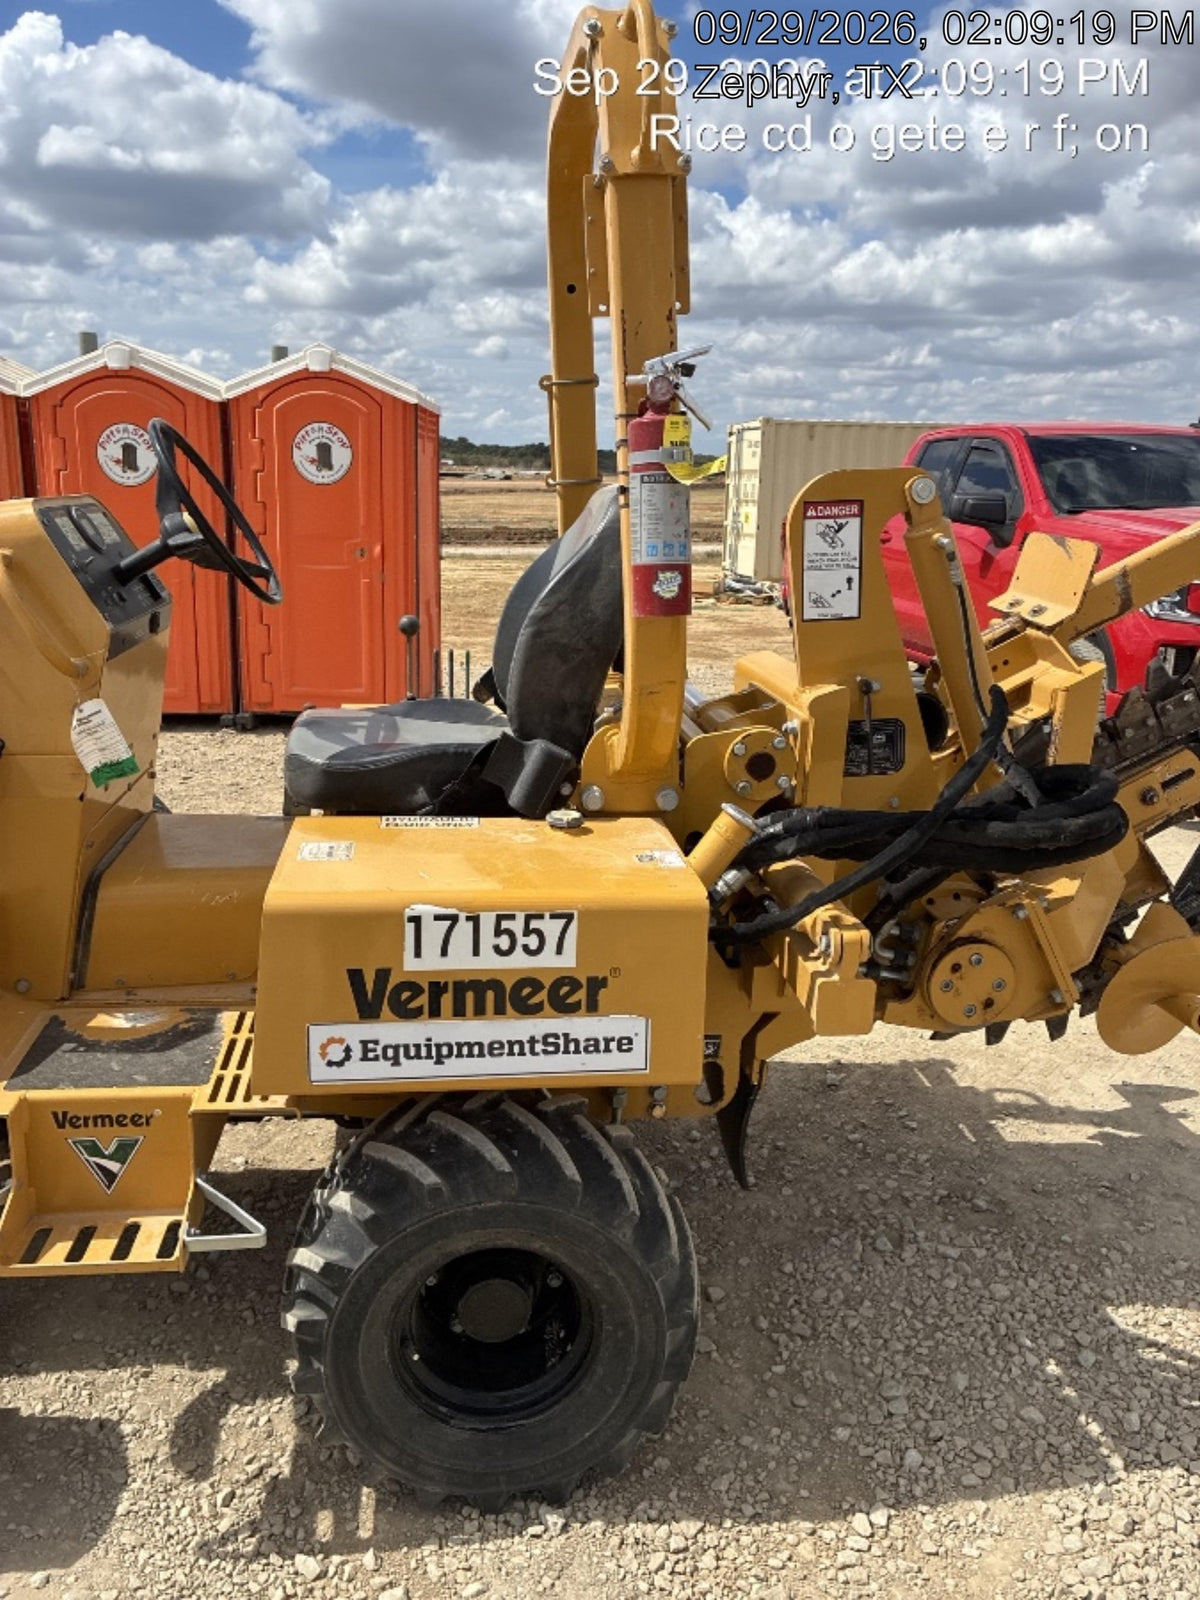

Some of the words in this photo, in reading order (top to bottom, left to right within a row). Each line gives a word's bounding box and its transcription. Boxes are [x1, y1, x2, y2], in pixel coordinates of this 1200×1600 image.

[817, 504, 858, 517] DANGER
[406, 912, 575, 959] 171557
[346, 967, 609, 1020] Vermeer
[358, 1032, 635, 1067] EquipmentShare
[51, 1110, 154, 1130] Vermeer
